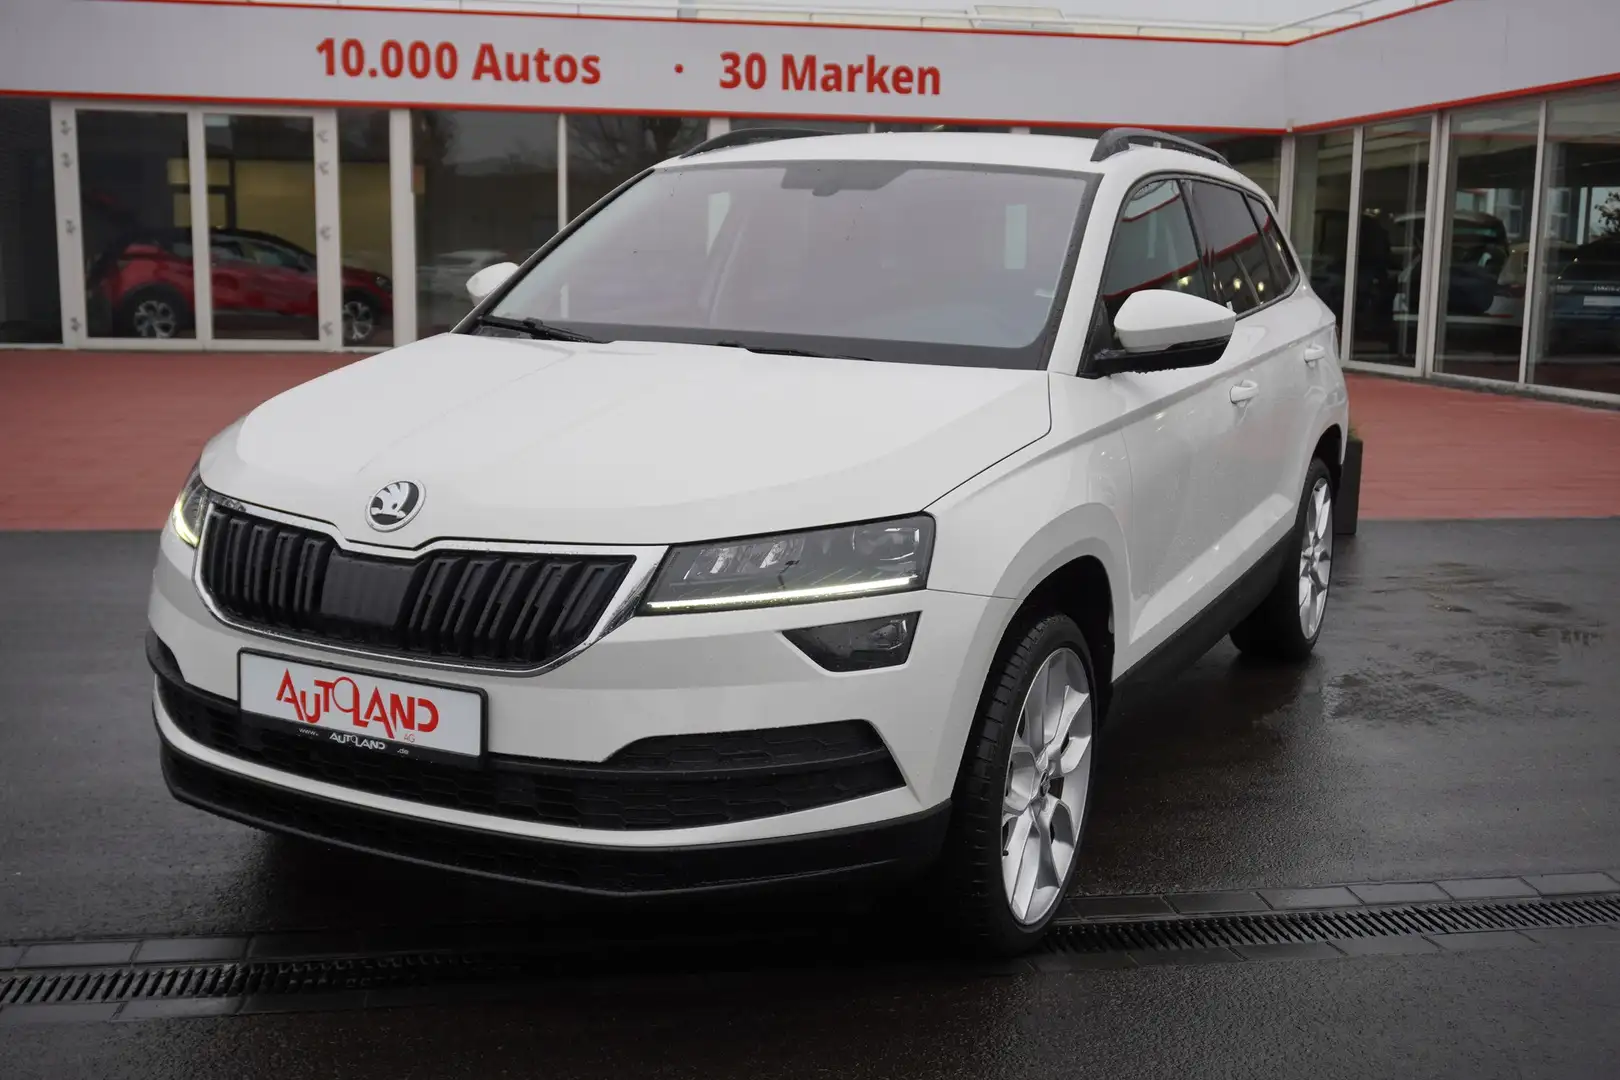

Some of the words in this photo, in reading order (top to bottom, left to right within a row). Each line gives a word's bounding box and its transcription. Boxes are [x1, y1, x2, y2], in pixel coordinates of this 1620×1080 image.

[317, 37, 458, 80] 10.000
[472, 43, 600, 85] Autos
[720, 52, 767, 90] 30
[781, 53, 941, 95] Marken
[329, 732, 386, 750] AUTOLAND
[403, 732, 415, 743] AG
